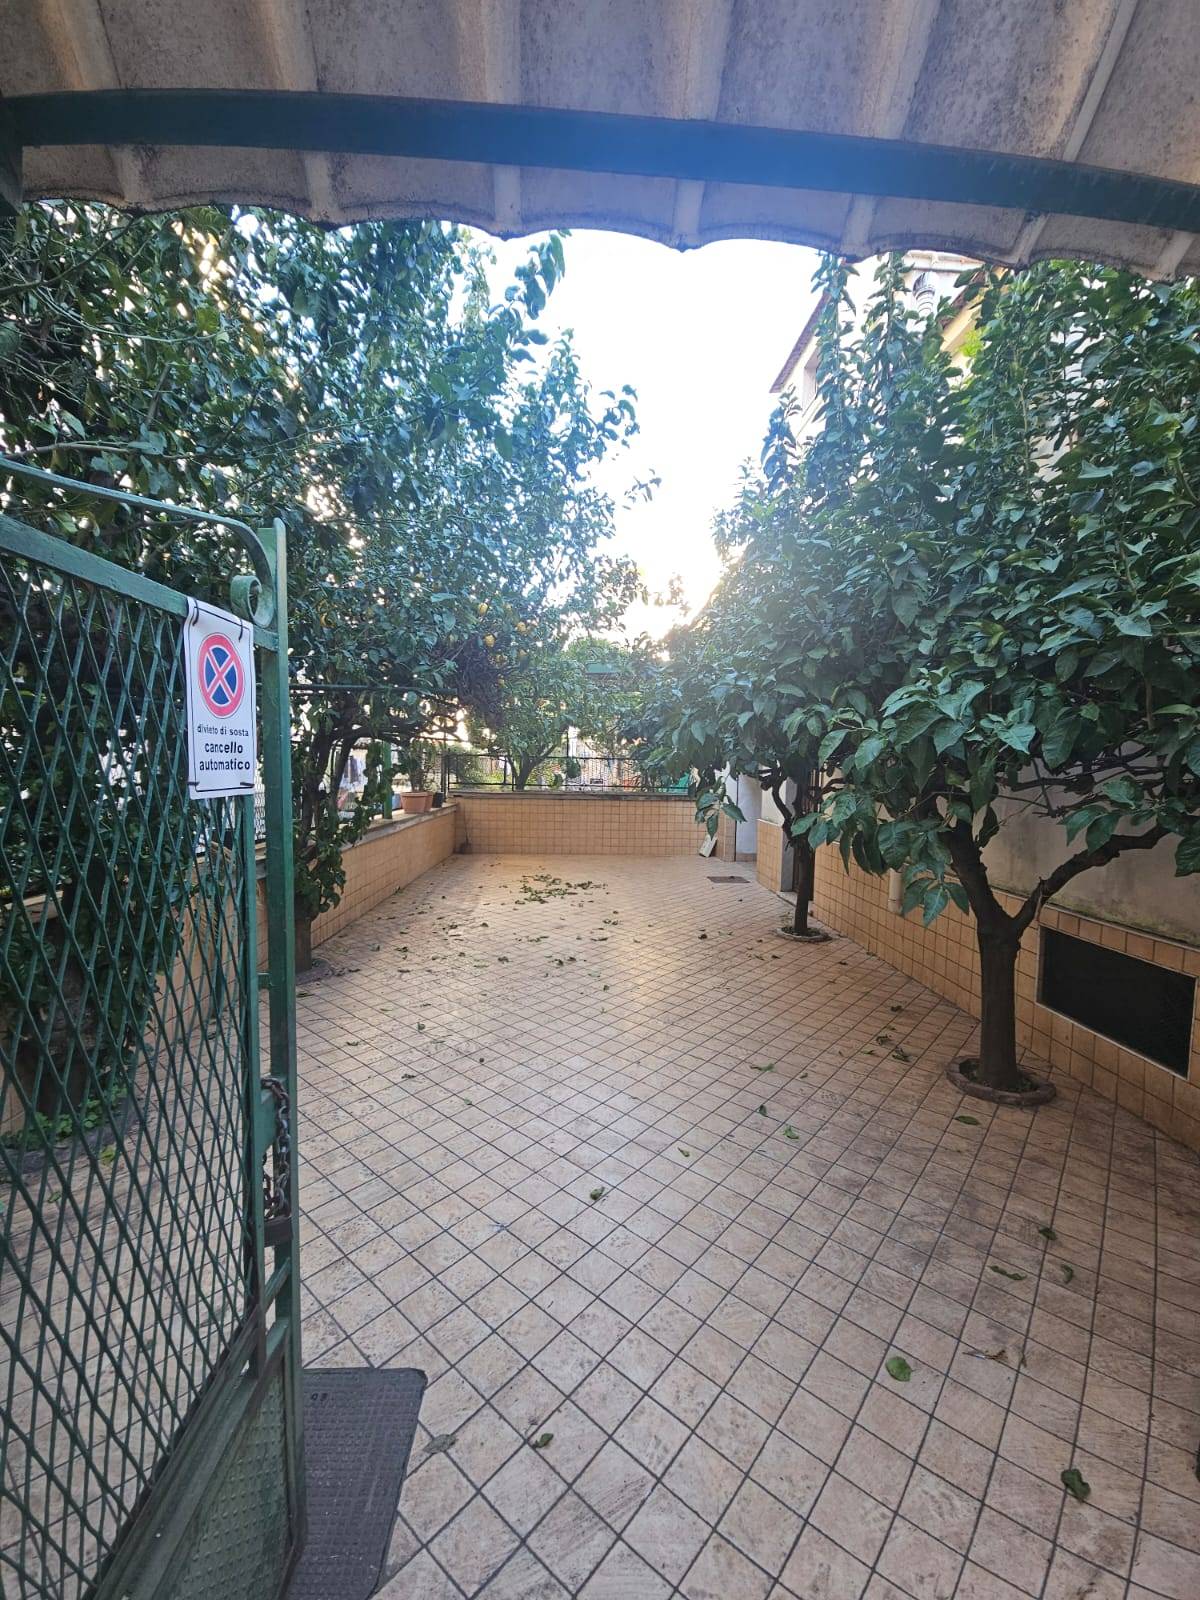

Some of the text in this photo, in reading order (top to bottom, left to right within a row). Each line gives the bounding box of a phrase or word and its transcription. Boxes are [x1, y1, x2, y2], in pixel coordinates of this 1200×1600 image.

[197, 724, 248, 736] divieto di sosta
[204, 742, 243, 754] cancello
[200, 758, 250, 770] automatico
